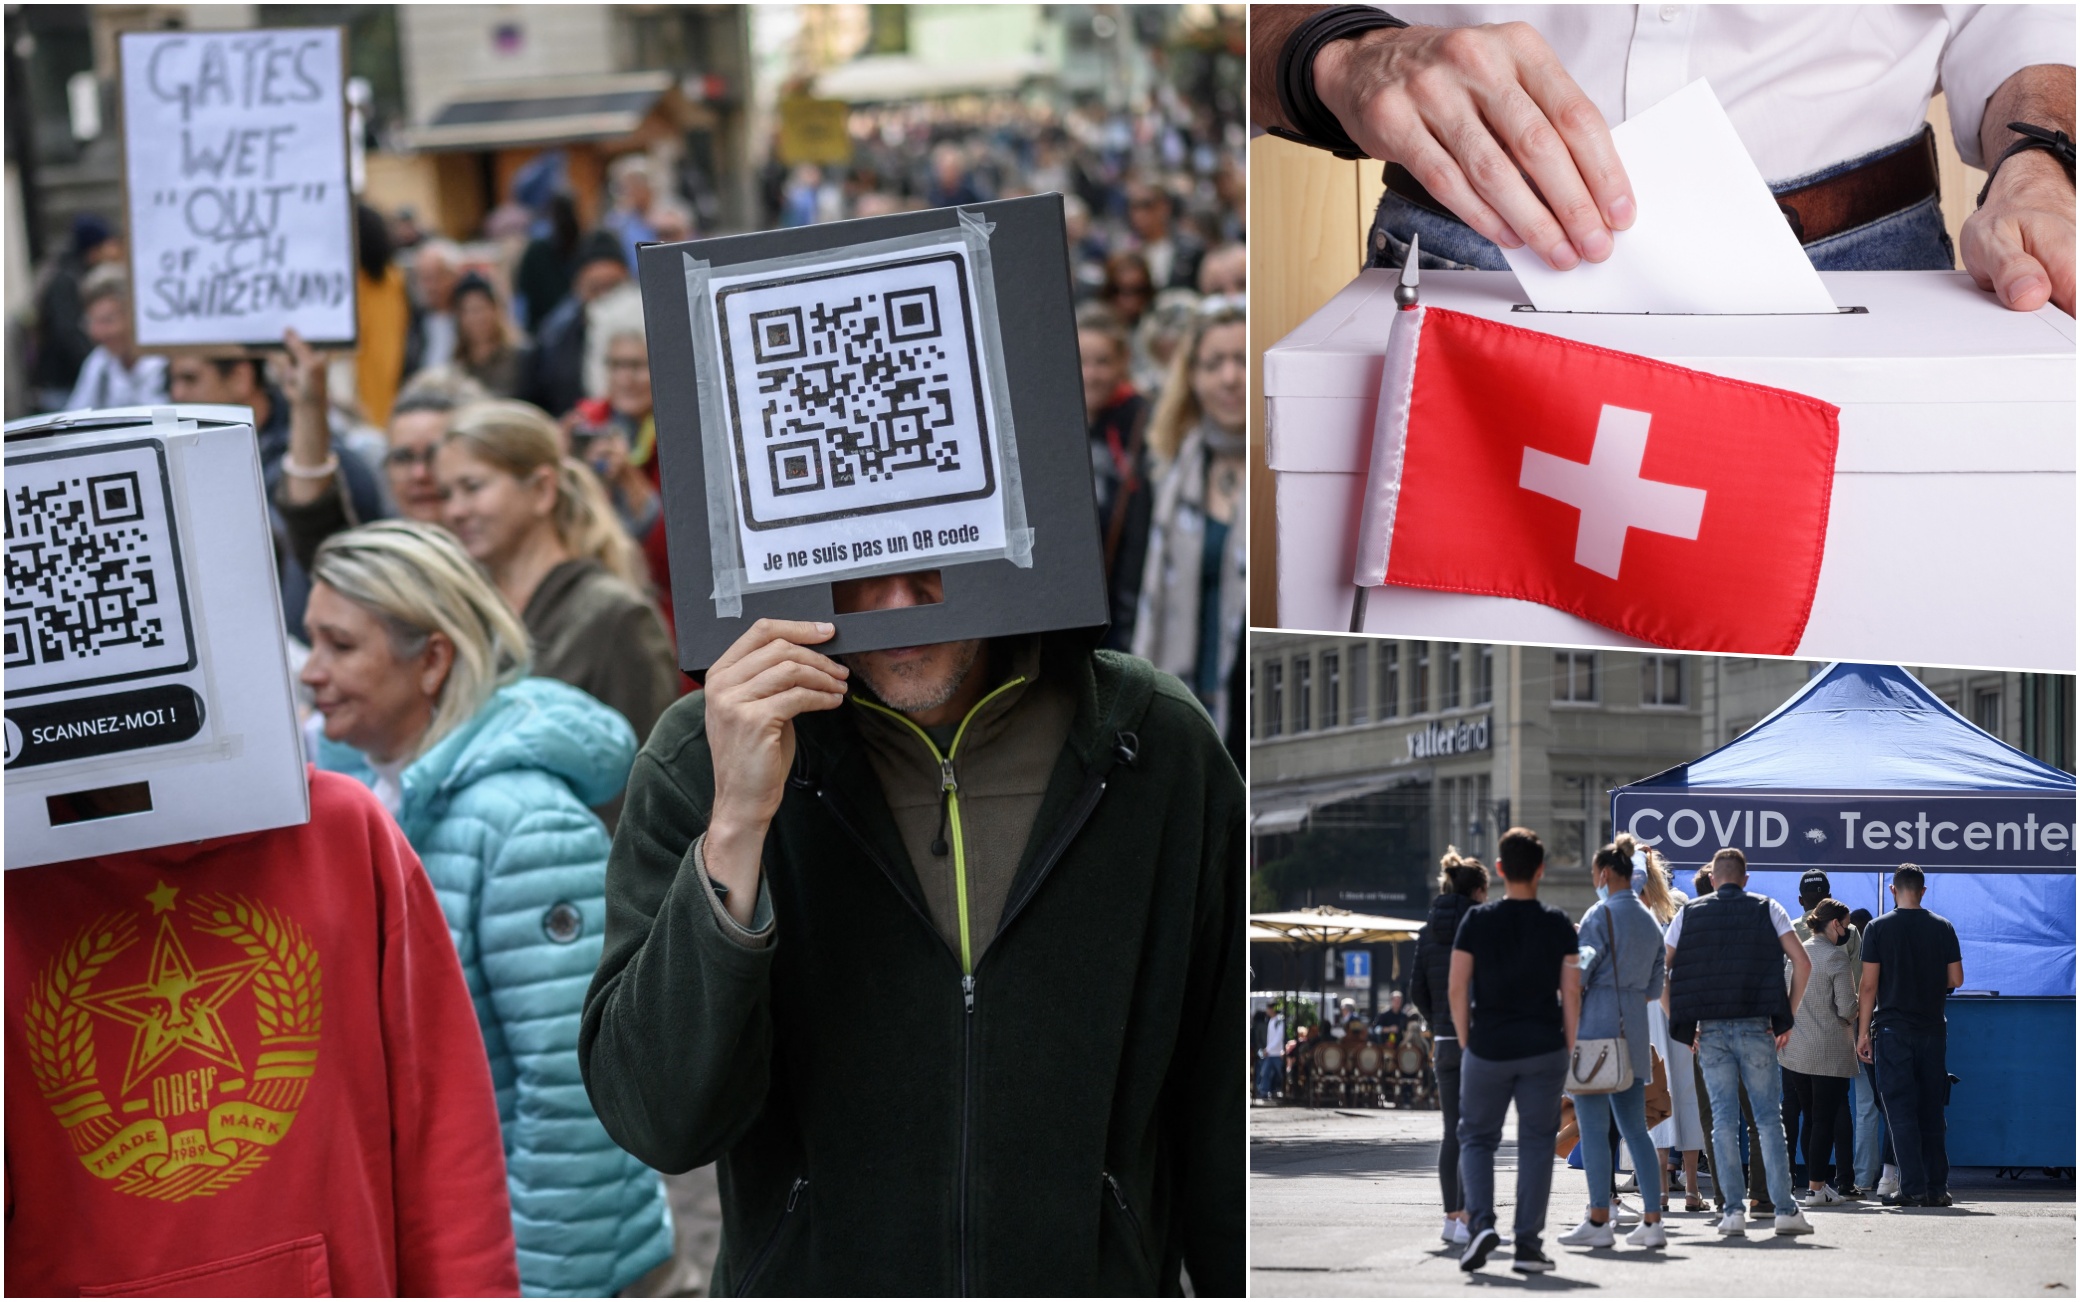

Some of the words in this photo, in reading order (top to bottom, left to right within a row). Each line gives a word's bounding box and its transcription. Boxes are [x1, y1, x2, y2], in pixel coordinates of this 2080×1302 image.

[147, 37, 325, 122] GATES
[180, 125, 296, 180] WEF
[144, 272, 346, 322] SWITZERLAND
[763, 552, 783, 572] Je
[787, 549, 808, 569] ne
[812, 541, 848, 564] suis
[851, 538, 883, 562] pas
[886, 534, 909, 553] un
[912, 529, 934, 551] QR
[937, 524, 980, 547] code
[31, 709, 166, 744] SCANNEZ-MOI
[1628, 808, 1790, 848] COVID
[93, 1131, 157, 1171] TRADE
[220, 1114, 281, 1135] MARK
